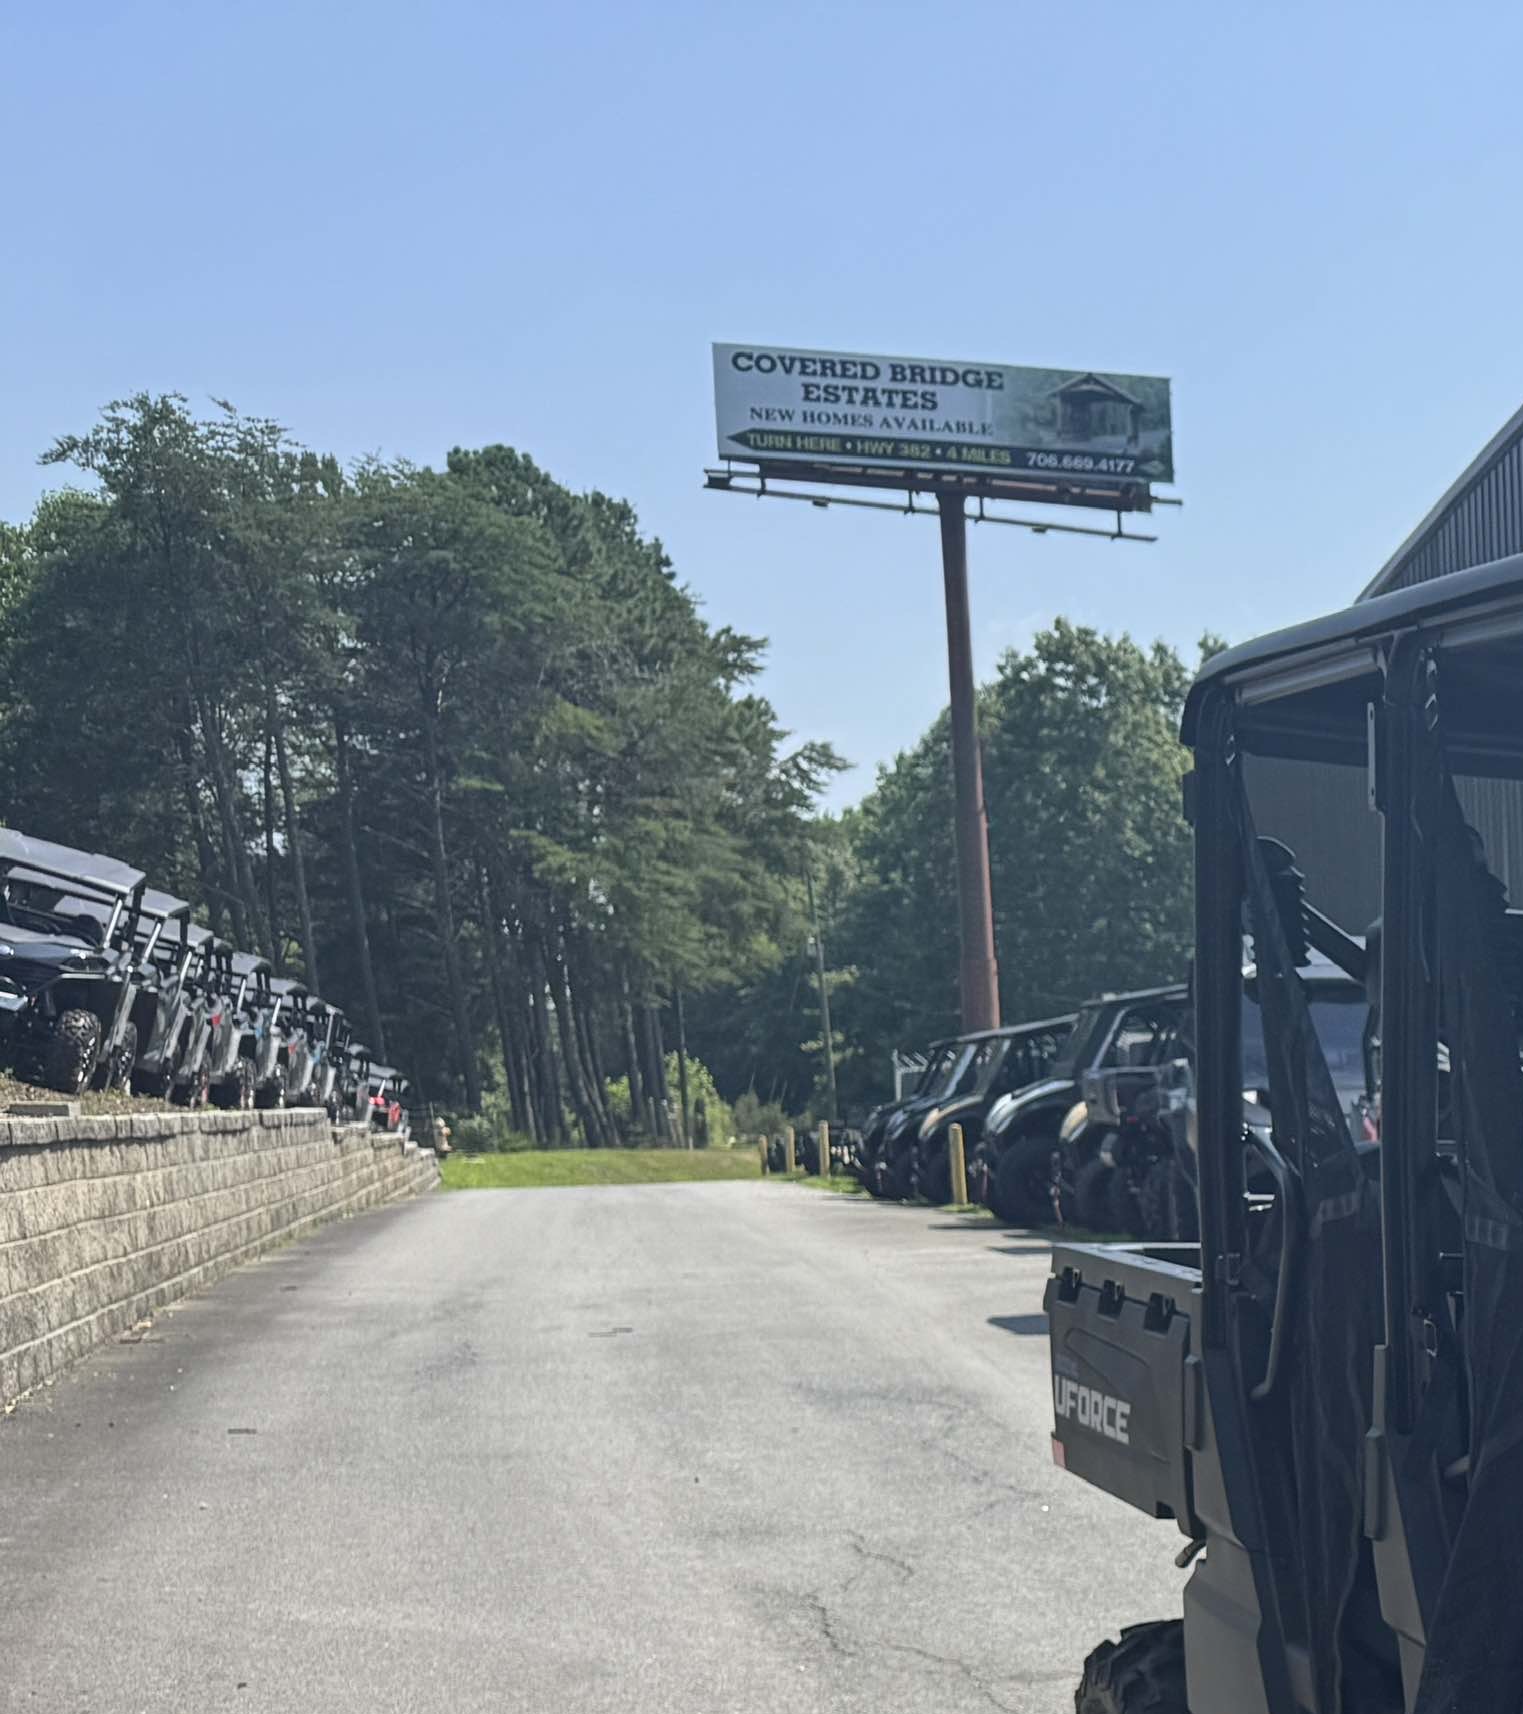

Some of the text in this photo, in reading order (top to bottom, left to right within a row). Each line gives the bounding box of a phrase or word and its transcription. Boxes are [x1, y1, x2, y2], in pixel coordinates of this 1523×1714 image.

[731, 351, 1005, 391] COVERED BRIDGE
[801, 383, 939, 411] ESTATES
[749, 407, 994, 436] NEW HOMES AVAILABLE
[747, 431, 792, 449] TURN
[796, 435, 842, 451] HERE
[856, 440, 895, 456] HWY
[945, 445, 958, 460] 4
[961, 446, 1011, 465] MILES
[1055, 1375, 1131, 1445] UFORCE
